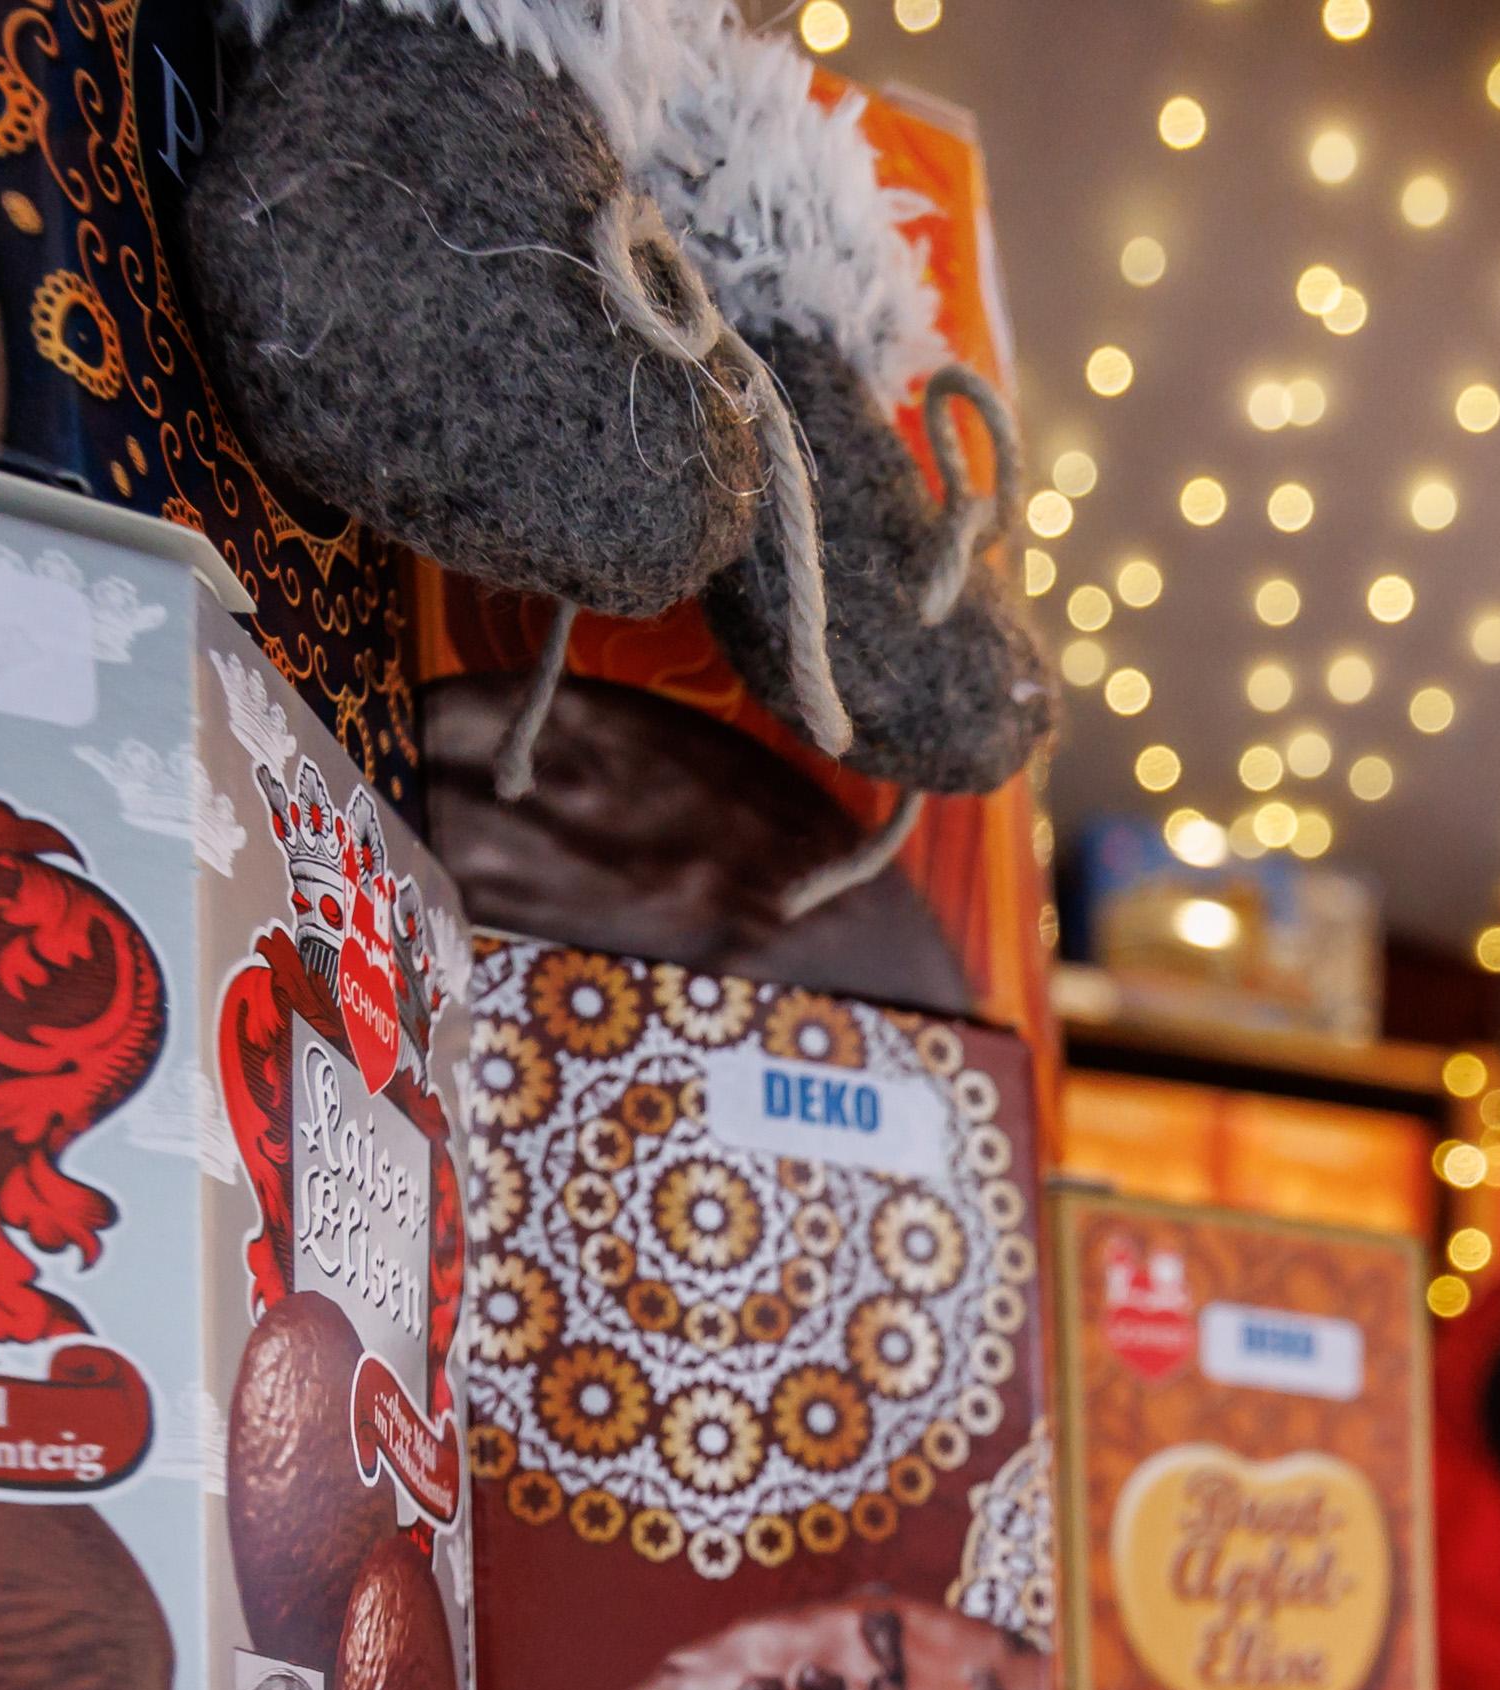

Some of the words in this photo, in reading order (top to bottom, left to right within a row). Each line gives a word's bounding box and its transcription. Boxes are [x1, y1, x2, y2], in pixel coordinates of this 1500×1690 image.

[343, 971, 396, 1051] SCHMIDT
[762, 1068, 882, 1133] DEKO
[298, 1164, 422, 1340] Elisen
[373, 1392, 388, 1440] im
